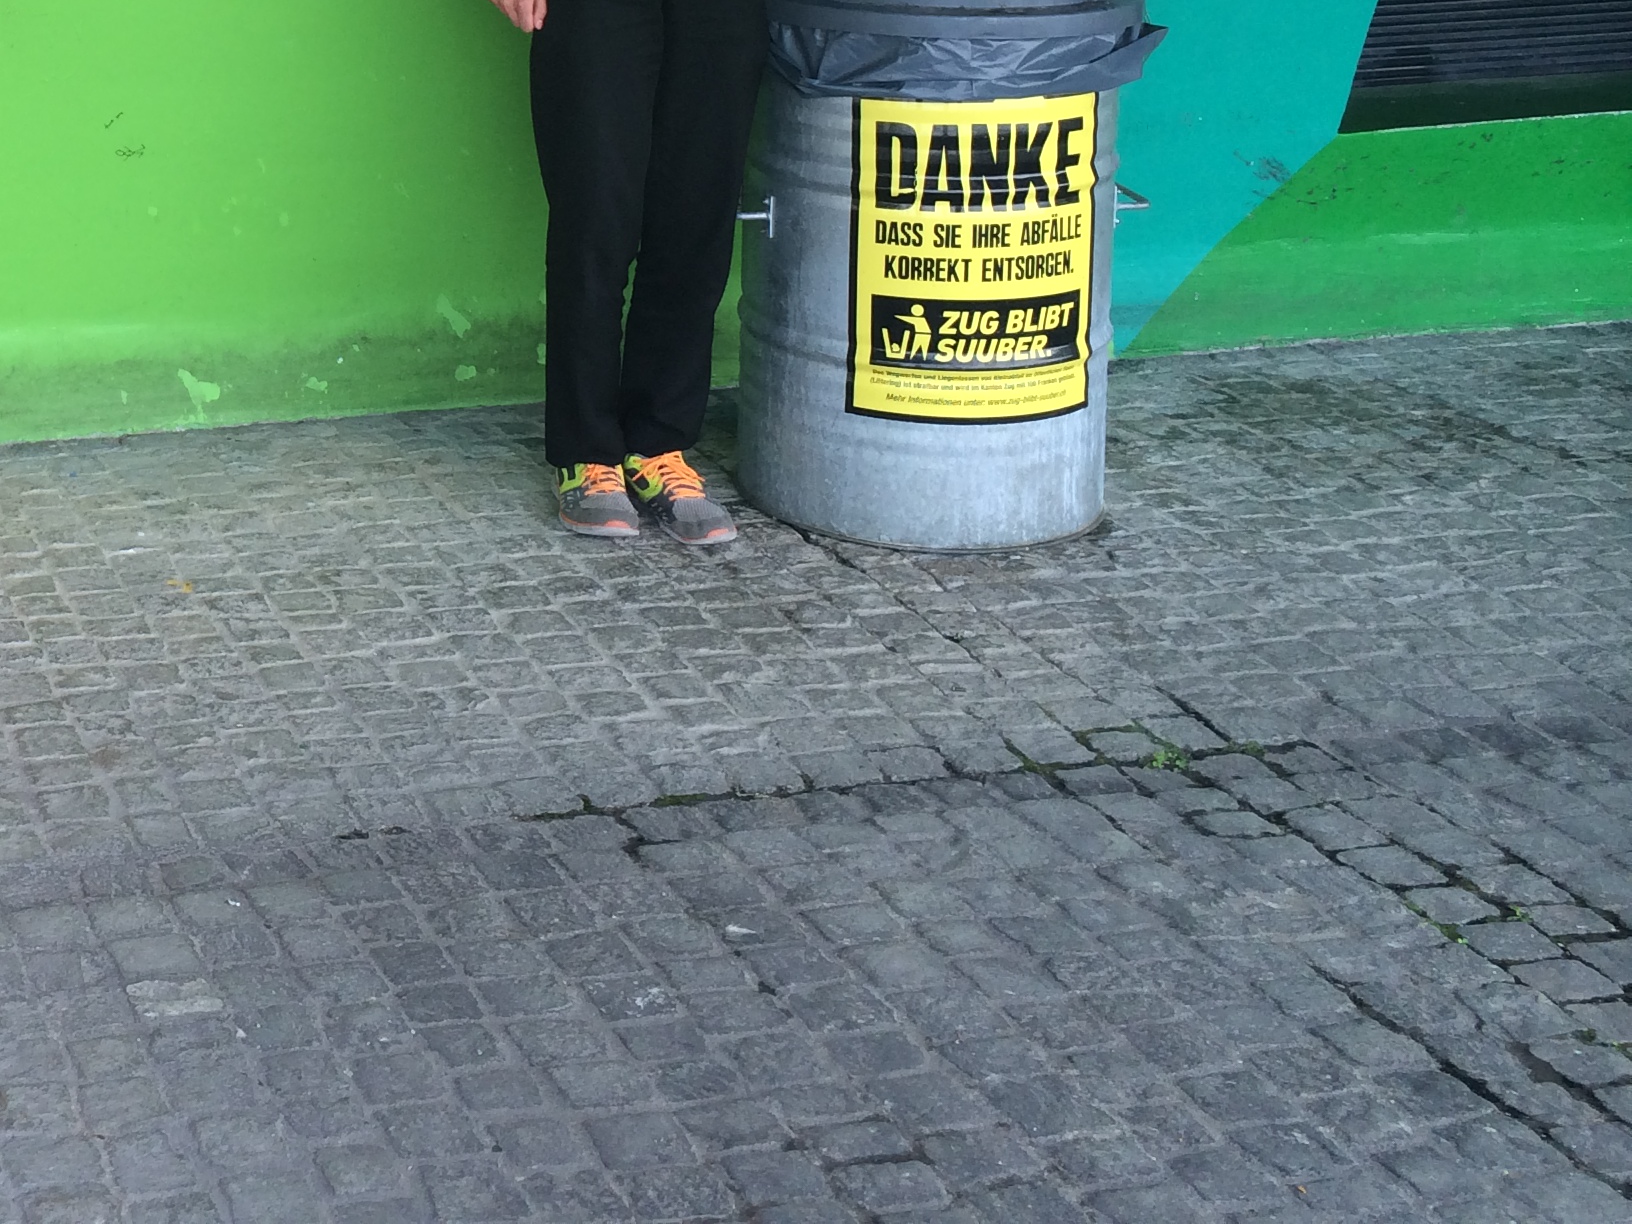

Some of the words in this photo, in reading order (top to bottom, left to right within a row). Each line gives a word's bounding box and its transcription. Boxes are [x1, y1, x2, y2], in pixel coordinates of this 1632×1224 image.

[875, 116, 1085, 213] DANKE
[875, 219, 924, 247] DASS
[933, 223, 962, 248] SIE
[972, 223, 1012, 248] IHRE
[1020, 214, 1082, 246] ABFÄLLE
[884, 254, 973, 283] KORREKT
[981, 250, 1074, 283] ENTSORGEN.
[938, 311, 999, 335] ZUG
[1005, 301, 1075, 334] BLIBT
[934, 334, 1052, 363] SUUBER.
